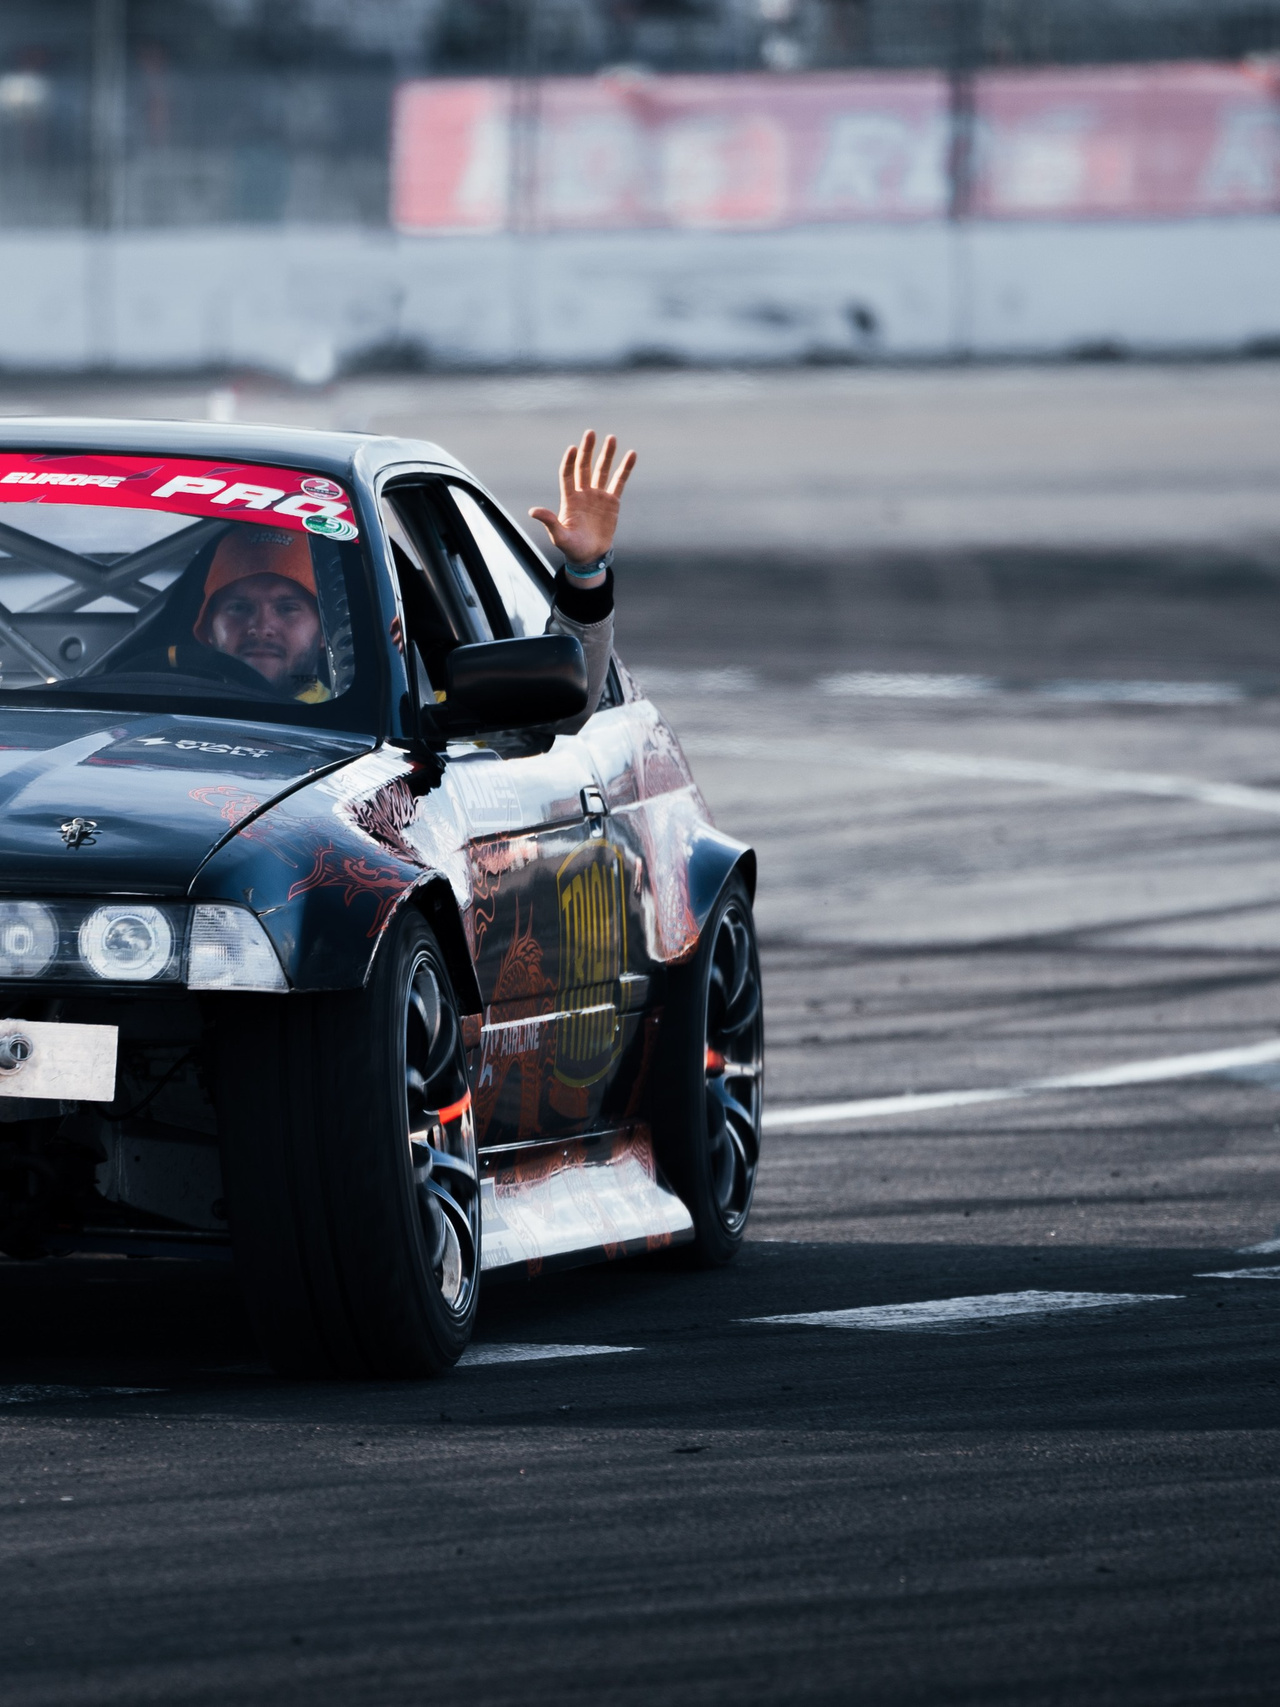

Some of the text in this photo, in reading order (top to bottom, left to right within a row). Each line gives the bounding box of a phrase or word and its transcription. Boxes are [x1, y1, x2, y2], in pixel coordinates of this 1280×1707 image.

[0, 472, 127, 488] EUROPE
[314, 480, 330, 491] 2
[151, 475, 347, 518] PRO
[324, 518, 340, 529] 5
[501, 1022, 540, 1057] AIRLINE
